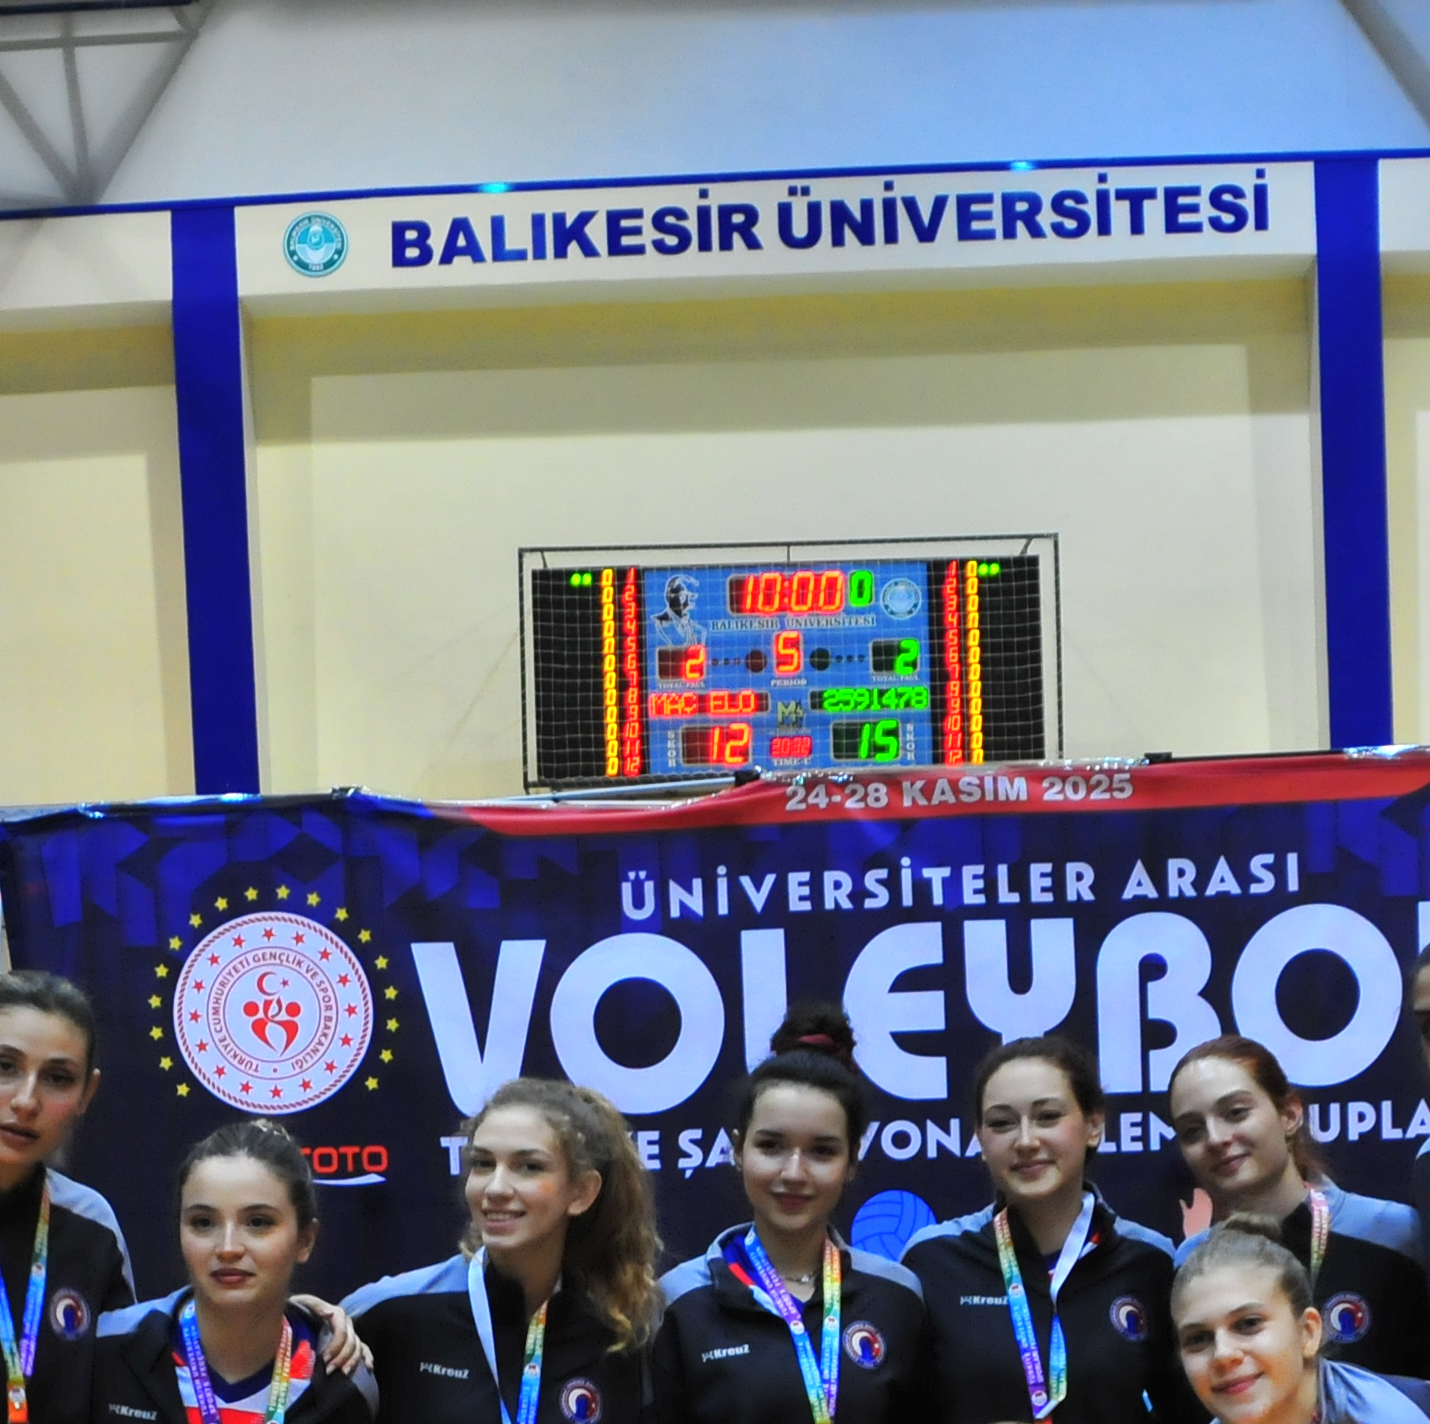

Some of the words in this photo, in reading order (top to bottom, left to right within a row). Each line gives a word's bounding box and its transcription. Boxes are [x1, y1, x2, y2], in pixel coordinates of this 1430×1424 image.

[391, 188, 763, 268] BALIKESİR
[777, 168, 1270, 249] ÜNİVERSİTESİ
[966, 560, 978, 577] 0
[602, 569, 614, 586] 0
[967, 577, 979, 594] 0
[602, 586, 614, 603] 0
[849, 570, 873, 606] 0
[603, 603, 614, 620] 0
[967, 595, 979, 611] 0
[968, 612, 979, 628] 0
[603, 621, 615, 637] 0
[969, 629, 980, 646] 0
[604, 638, 615, 654] 0
[774, 629, 803, 676] 5
[969, 646, 980, 663] 0
[604, 655, 616, 671] 0
[683, 645, 706, 682] 2
[895, 638, 919, 675] 2
[605, 672, 616, 688] 0
[969, 664, 981, 680] 0
[605, 689, 616, 705] 0
[970, 680, 981, 697] 0
[606, 706, 617, 723] 0
[970, 698, 982, 714] 0
[606, 723, 617, 740] 0
[971, 715, 982, 731] 0
[607, 740, 618, 757] 0
[711, 723, 752, 766] 12
[859, 719, 899, 761] 15
[972, 732, 983, 749] 0
[607, 757, 618, 775] 0
[785, 782, 888, 811] 24-28
[1042, 773, 1133, 801] 2025
[621, 857, 1097, 920] ÜNİVERSİTELER
[1122, 852, 1299, 900] ARASI
[252, 951, 305, 968] GENÇLİK
[305, 965, 320, 979] VE
[316, 979, 333, 1012] SPOR
